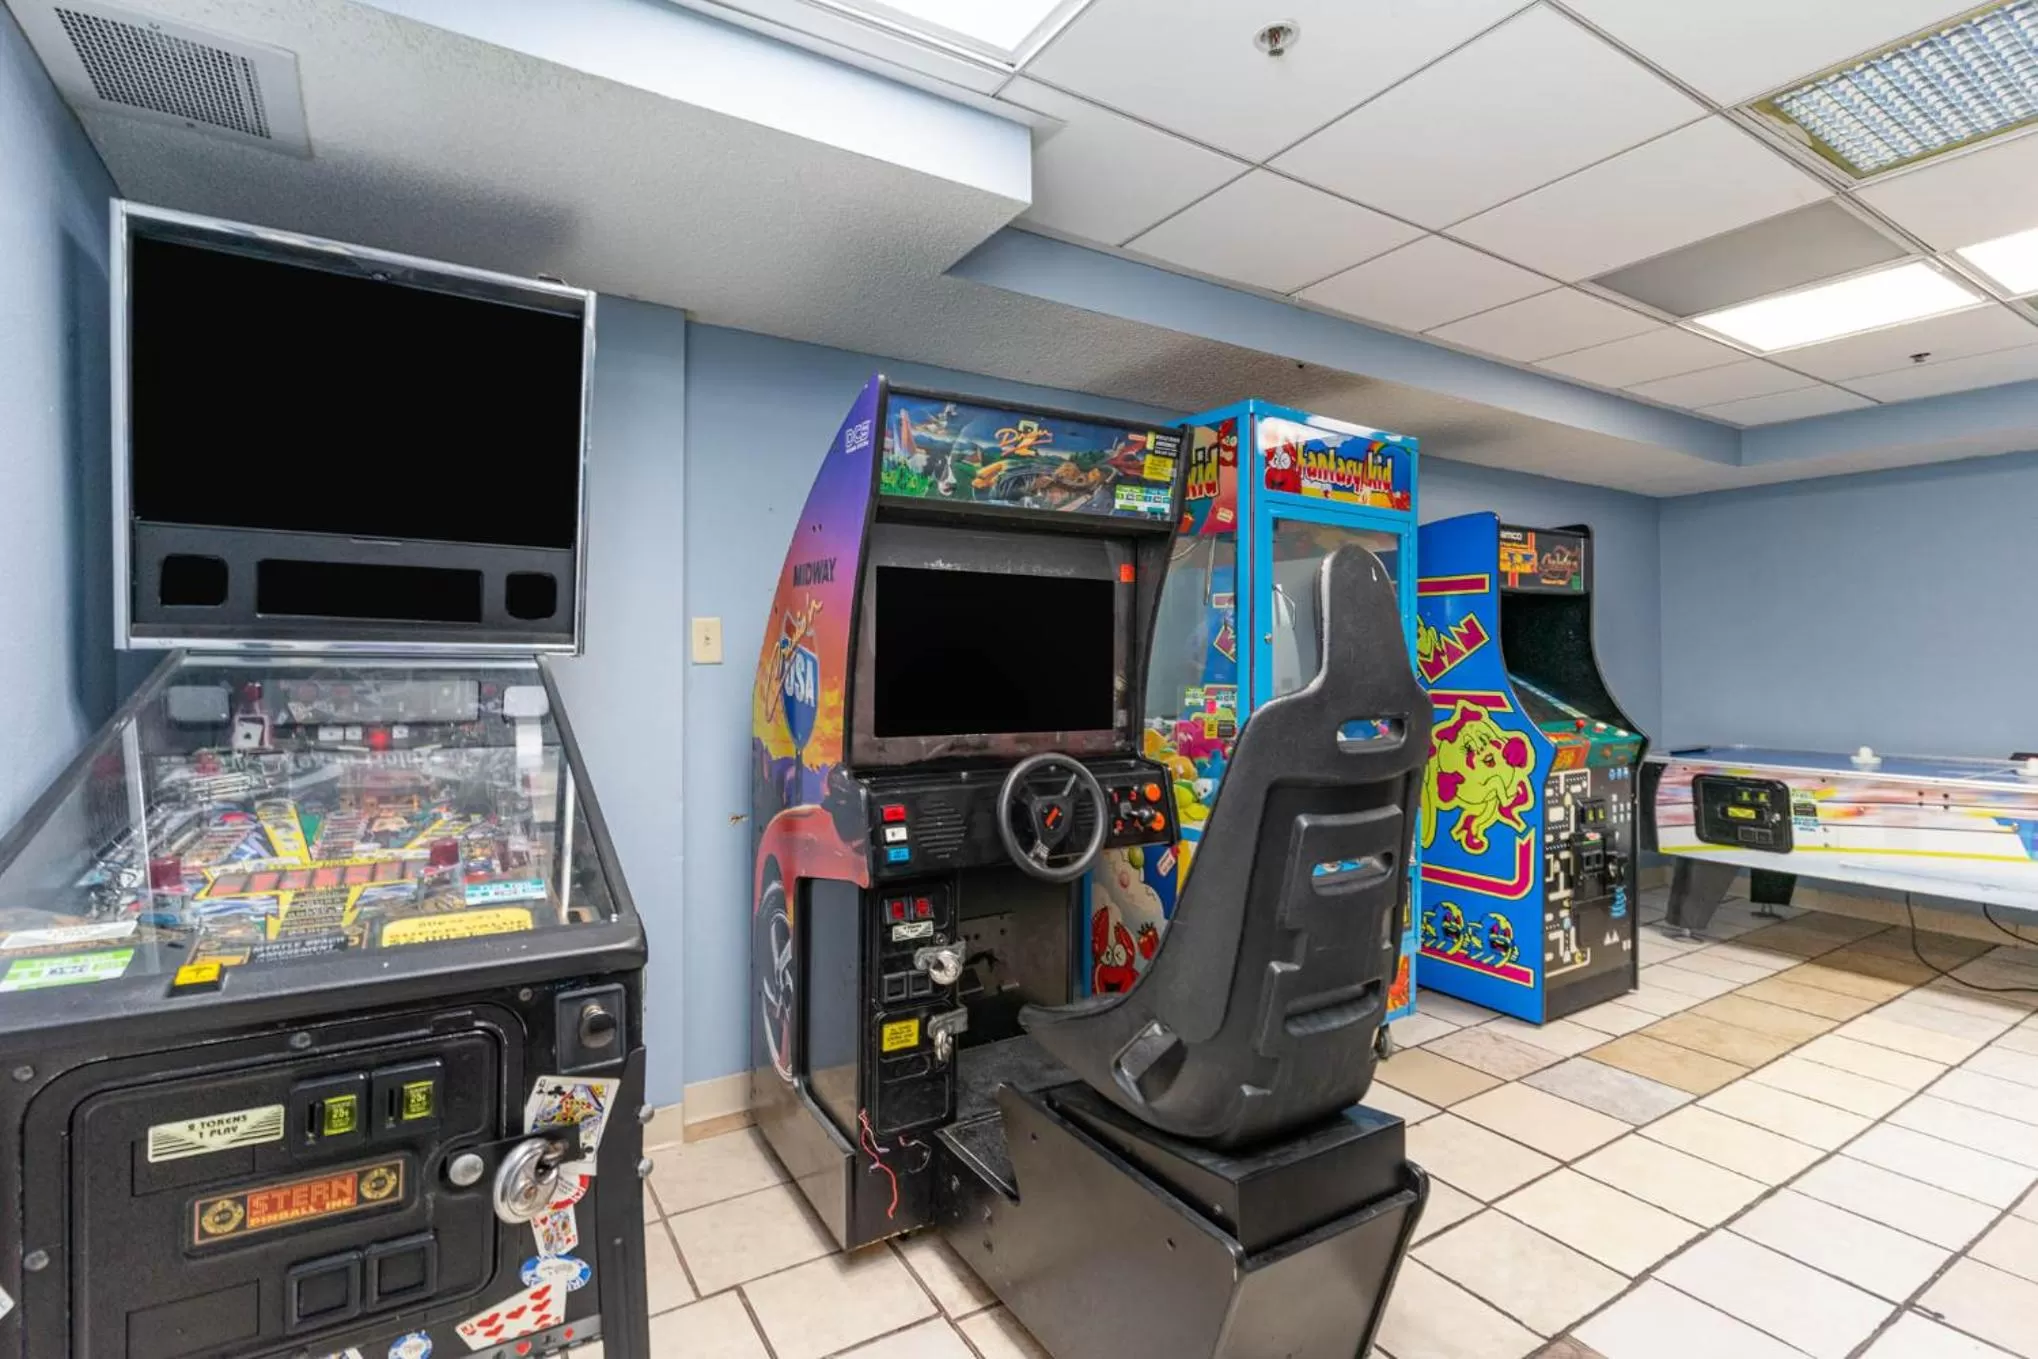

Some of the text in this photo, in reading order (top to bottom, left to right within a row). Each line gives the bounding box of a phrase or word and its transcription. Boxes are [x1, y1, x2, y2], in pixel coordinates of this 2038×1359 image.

[793, 558, 837, 587] MIDWAY
[783, 652, 816, 707] USA
[251, 1177, 352, 1217] STERN
